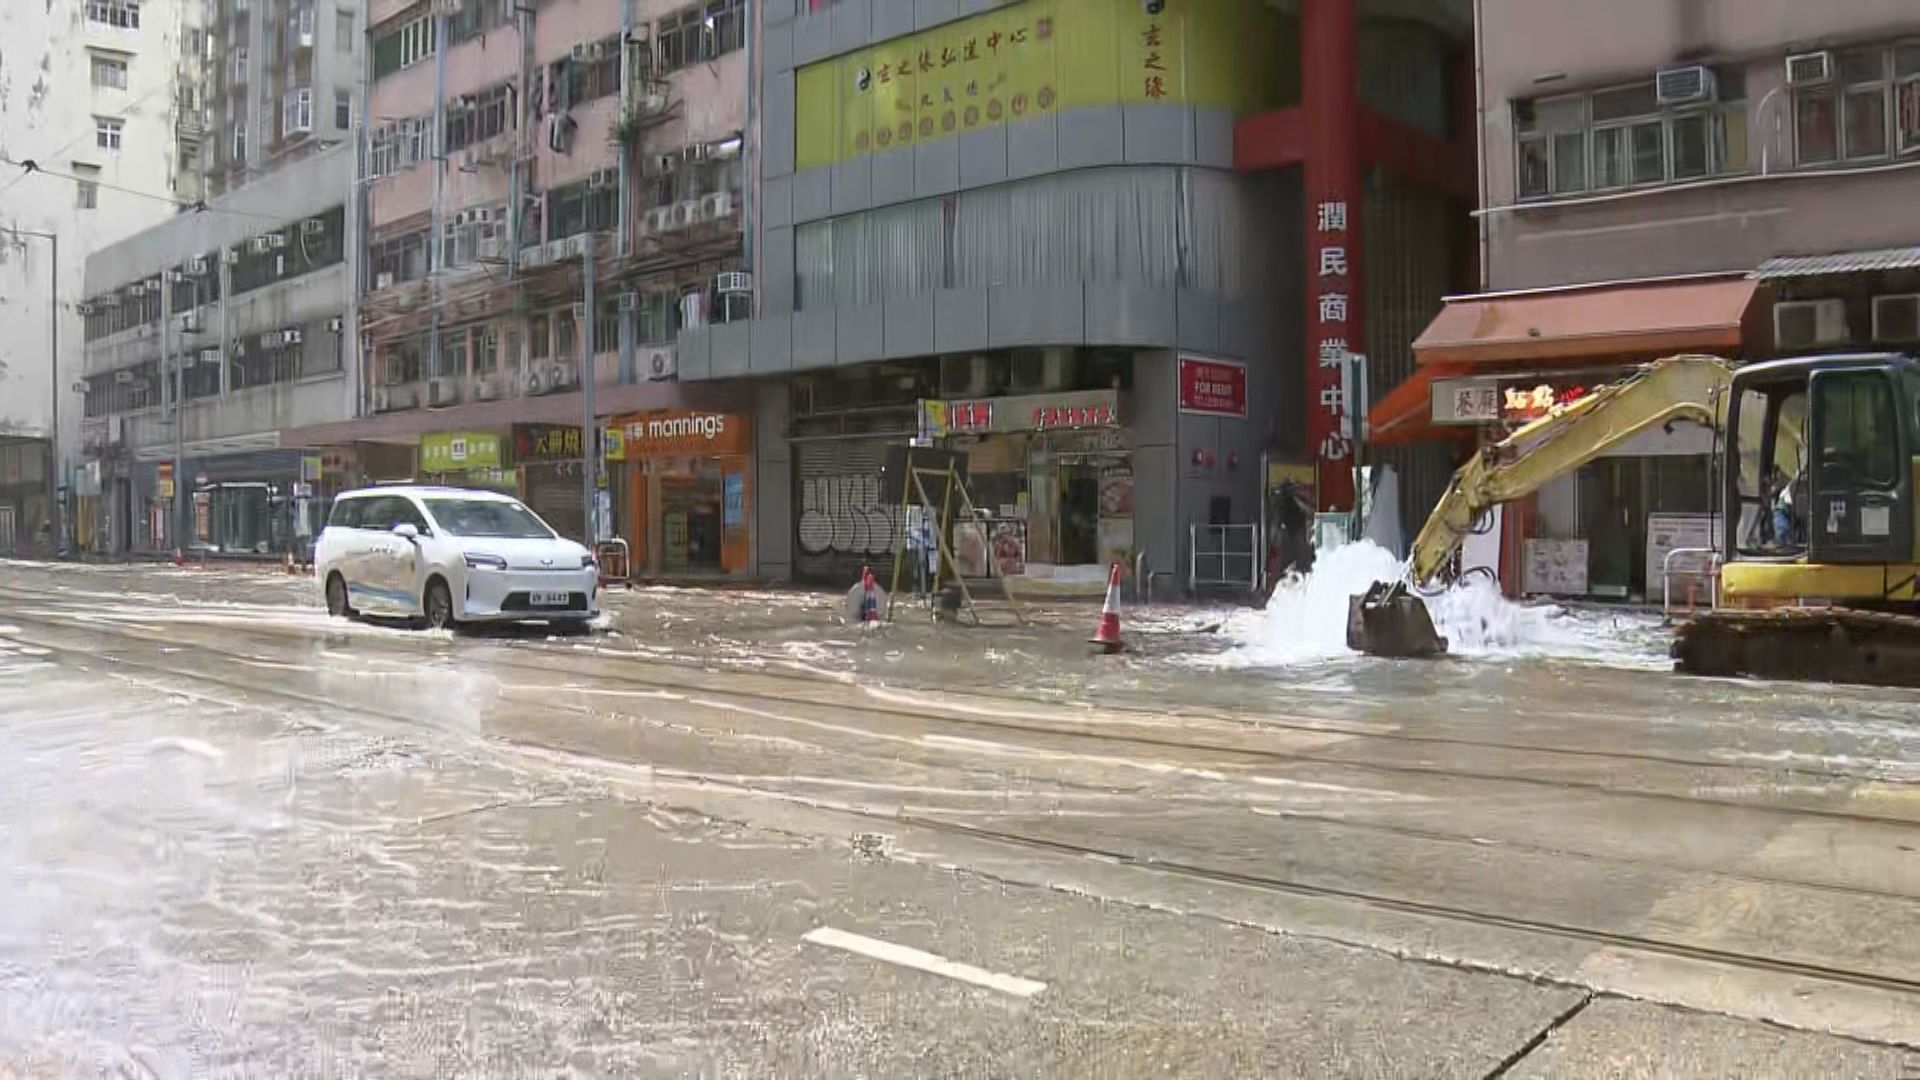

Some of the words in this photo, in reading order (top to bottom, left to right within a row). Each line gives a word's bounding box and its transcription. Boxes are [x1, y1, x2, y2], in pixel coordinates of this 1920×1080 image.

[1317, 202, 1349, 460] 潤民商業中心
[1194, 380, 1211, 394] FOR
[648, 411, 725, 440] mannings
